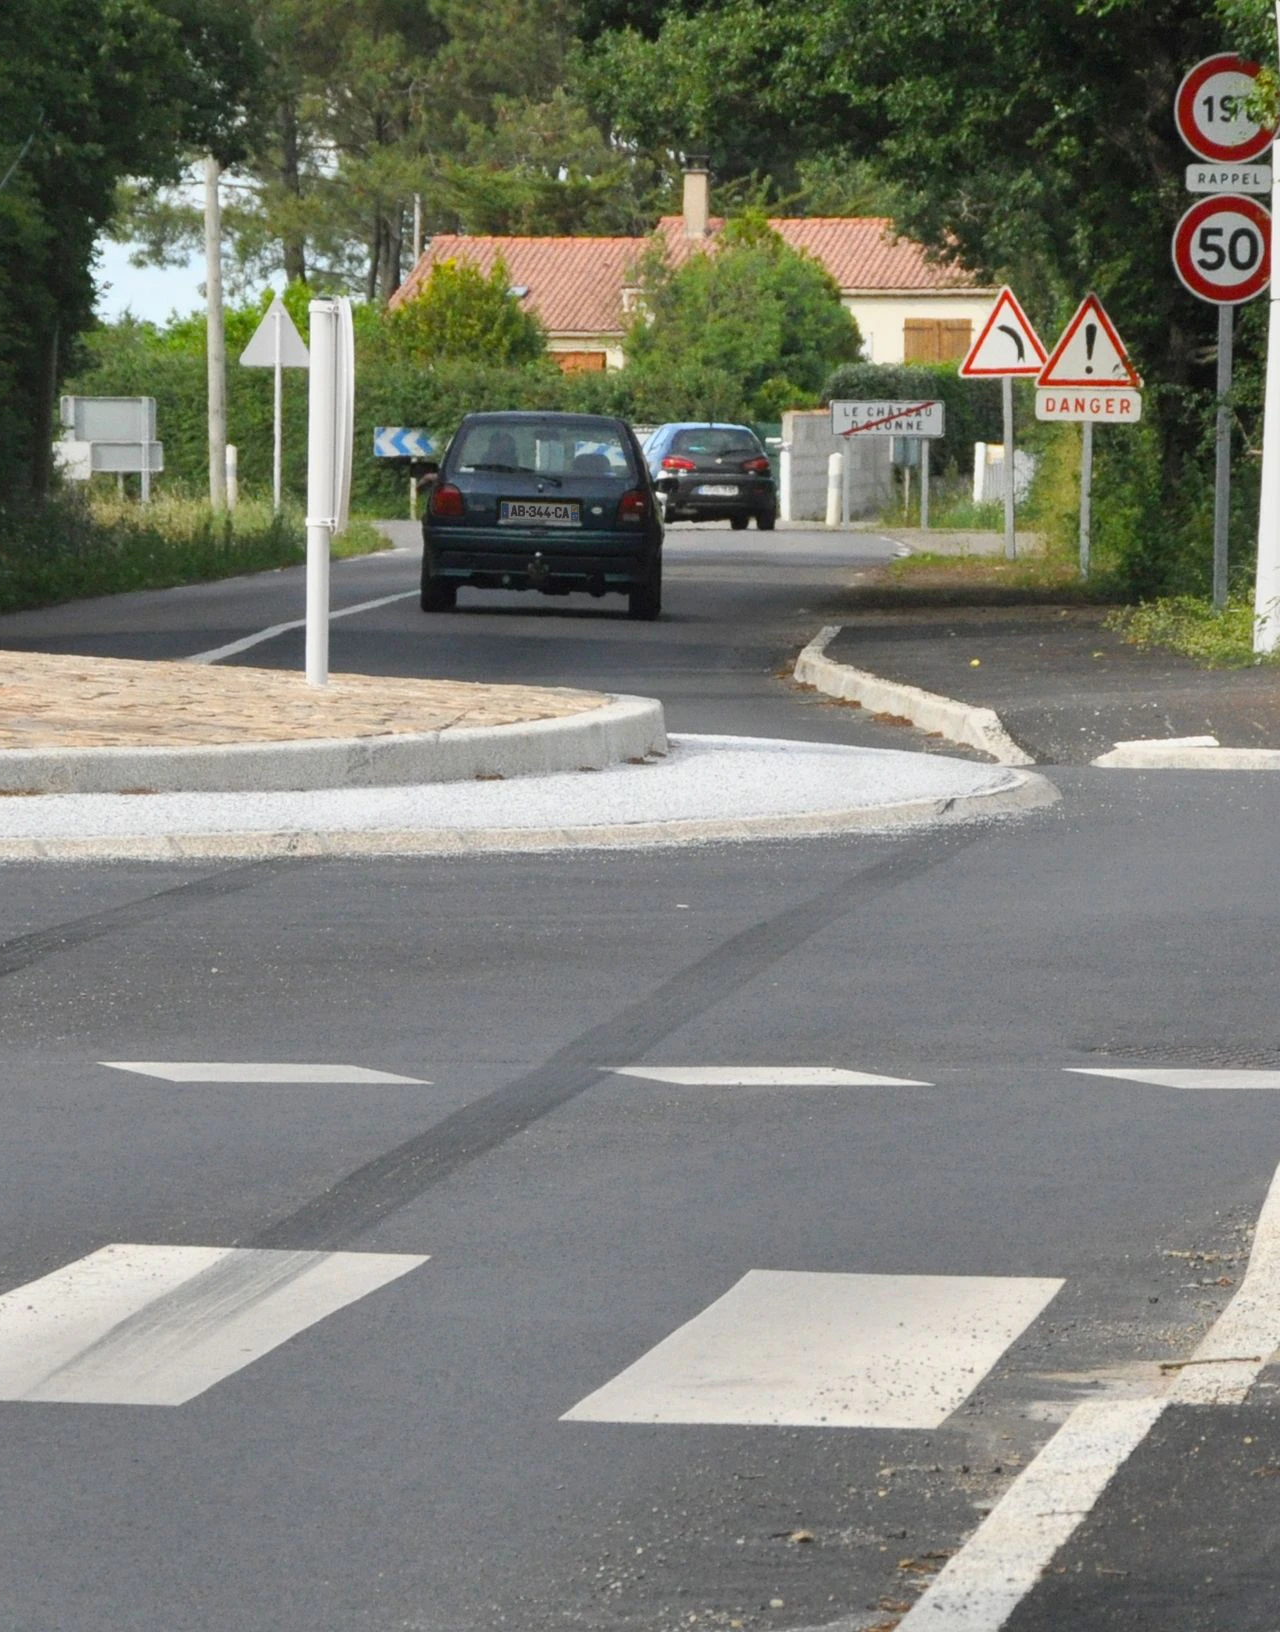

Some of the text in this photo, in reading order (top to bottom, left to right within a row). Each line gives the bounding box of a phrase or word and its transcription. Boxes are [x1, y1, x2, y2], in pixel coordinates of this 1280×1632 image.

[1197, 172, 1261, 185] RAPPEL
[1197, 227, 1259, 271] 50
[843, 406, 859, 417] LE
[1045, 398, 1131, 414] DANGER
[510, 505, 570, 519] AB-344-CA
